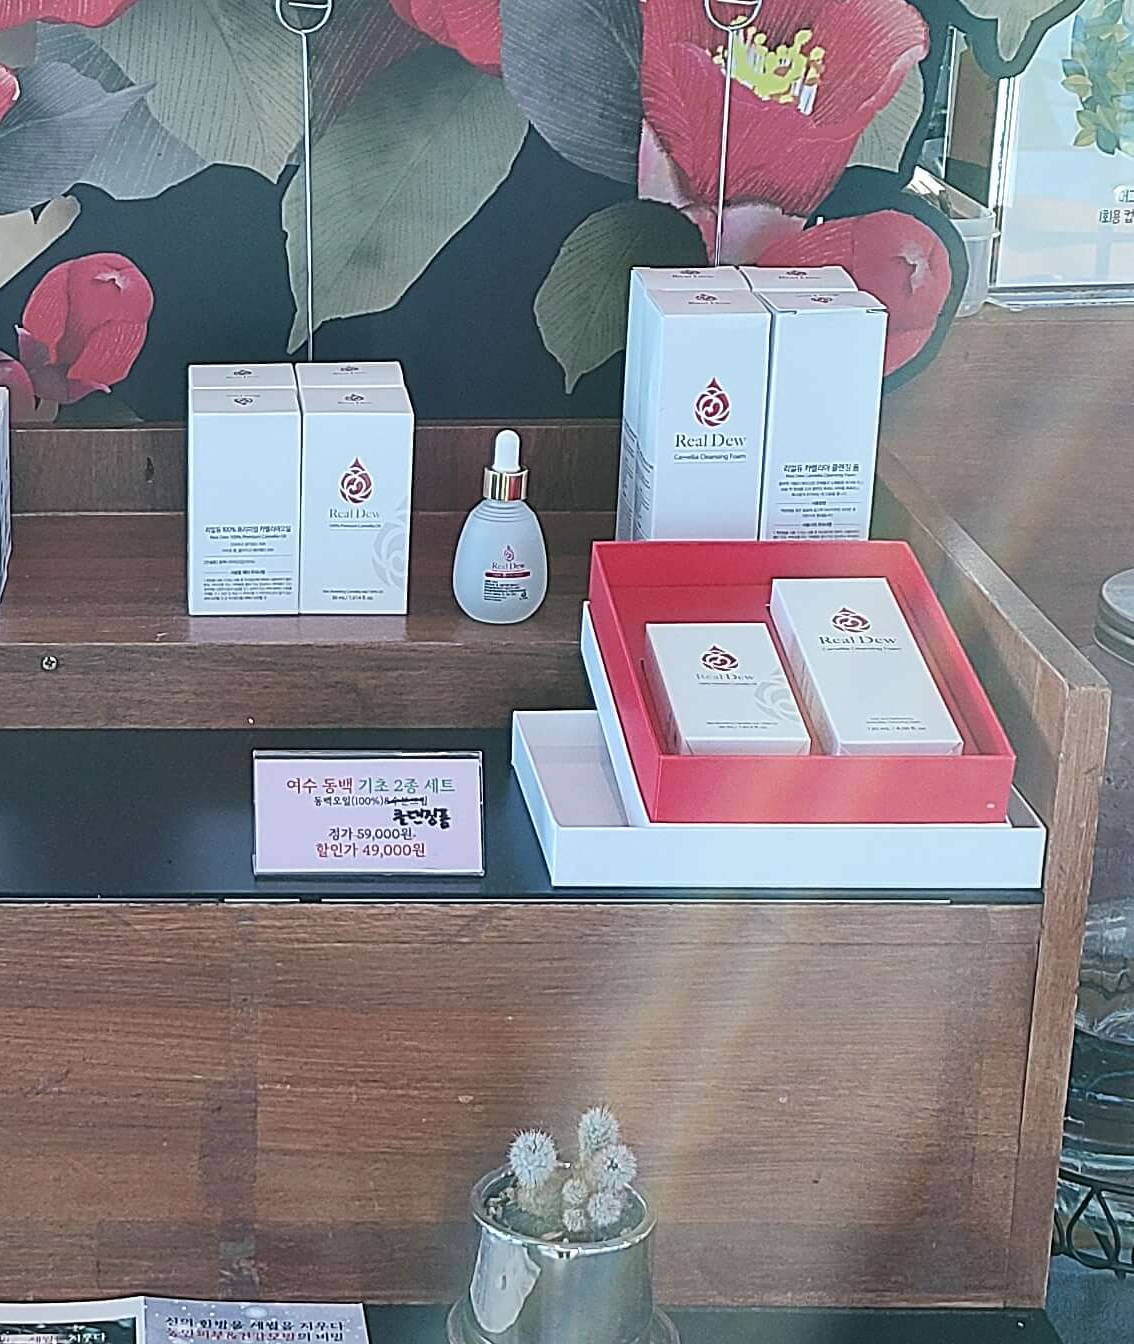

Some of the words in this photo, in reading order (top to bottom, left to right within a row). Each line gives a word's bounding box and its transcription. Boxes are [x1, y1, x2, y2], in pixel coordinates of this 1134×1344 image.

[675, 433, 707, 447] Real
[712, 433, 746, 446] Dew
[330, 508, 352, 518] Real
[356, 508, 379, 518] Dew
[819, 636, 854, 644] Real
[859, 635, 897, 644] Dew
[287, 778, 318, 794] 여수
[322, 777, 353, 794] 동백
[358, 778, 389, 794] 기초
[394, 778, 419, 794] 2종
[424, 778, 455, 793] 세트
[329, 828, 353, 840] 정가
[356, 828, 413, 841] 59,000원
[316, 843, 358, 858] 할인가
[363, 842, 425, 858] 49,000원
